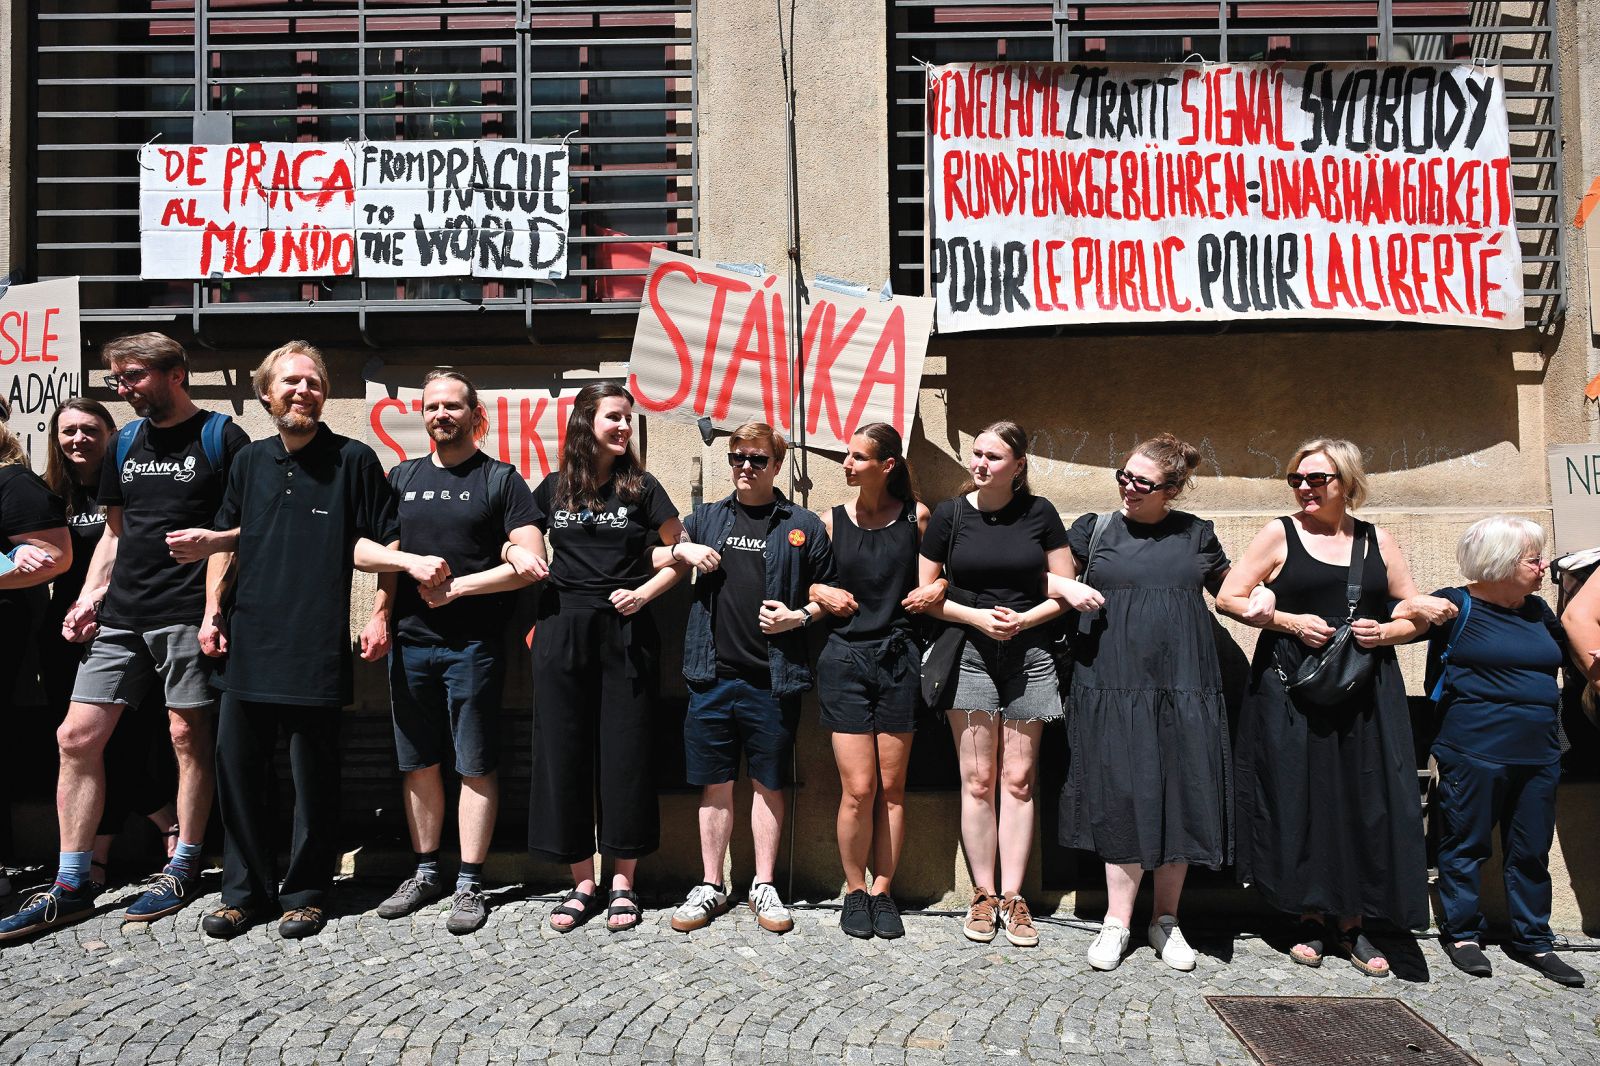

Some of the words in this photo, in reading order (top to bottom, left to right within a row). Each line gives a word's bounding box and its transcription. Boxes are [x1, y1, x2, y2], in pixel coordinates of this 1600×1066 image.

[1065, 65, 1179, 142] ZTRATIT
[1177, 60, 1295, 151] SIGNÁL
[1300, 63, 1494, 153] SVOBODY
[158, 147, 208, 186] DE
[223, 142, 356, 214] PRAGA
[362, 146, 424, 186] FROM
[427, 146, 566, 215] PRAGUE
[161, 198, 206, 226] AL
[360, 231, 406, 266] THE
[413, 213, 565, 271] WORLD
[363, 204, 395, 225] TO
[200, 221, 354, 276] MUNDO
[930, 236, 1031, 316] POUR
[1198, 233, 1304, 313] POUR
[1352, 231, 1507, 319] LIBERTÉ
[629, 260, 905, 446] STÁVKA
[134, 460, 180, 473] STÁVKA
